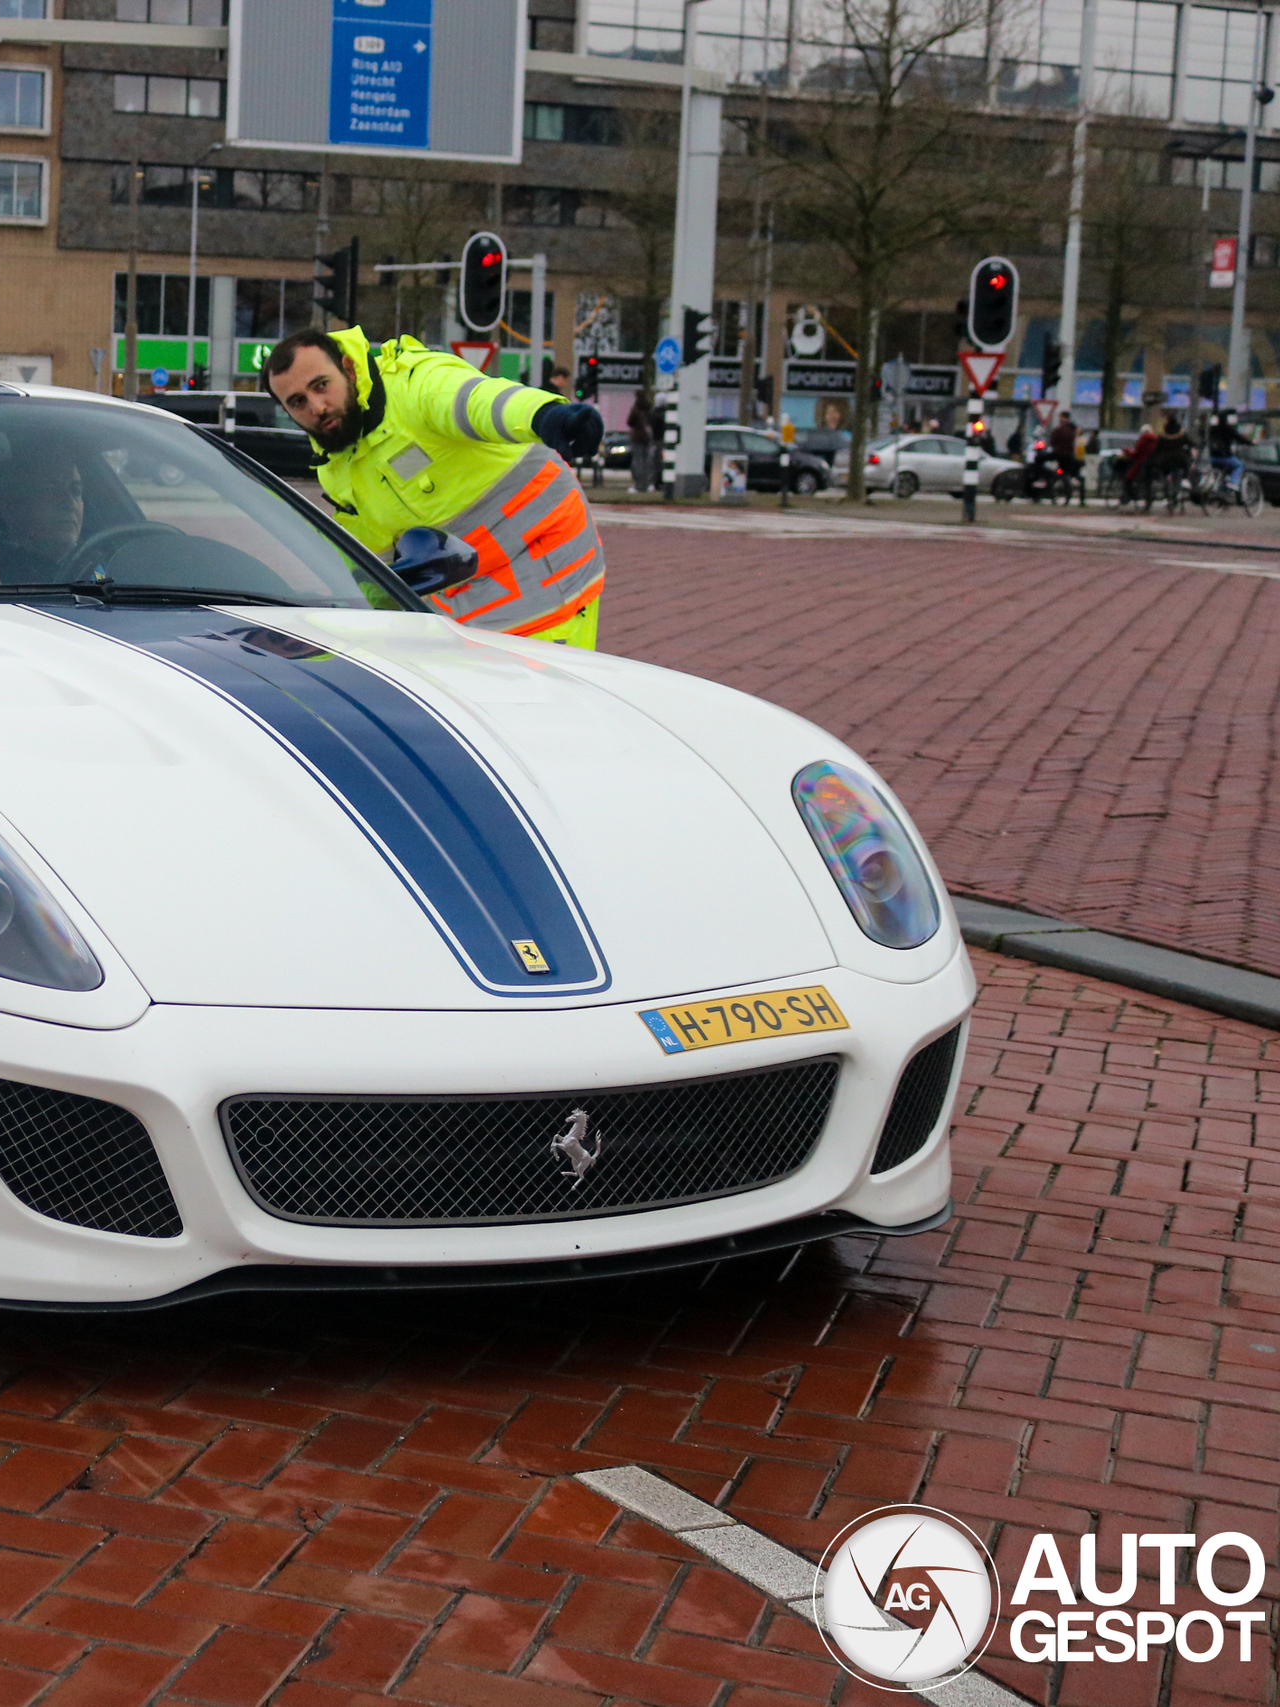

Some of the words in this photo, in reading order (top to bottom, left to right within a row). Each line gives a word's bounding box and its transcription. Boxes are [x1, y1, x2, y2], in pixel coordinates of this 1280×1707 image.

[352, 58, 378, 73] Ring
[381, 61, 403, 73] A10
[352, 74, 396, 87] Utrecht
[351, 103, 411, 118] Rotterdam
[350, 118, 404, 133] Zaanstad
[670, 993, 839, 1044] H-790-SH
[660, 1036, 678, 1047] NL
